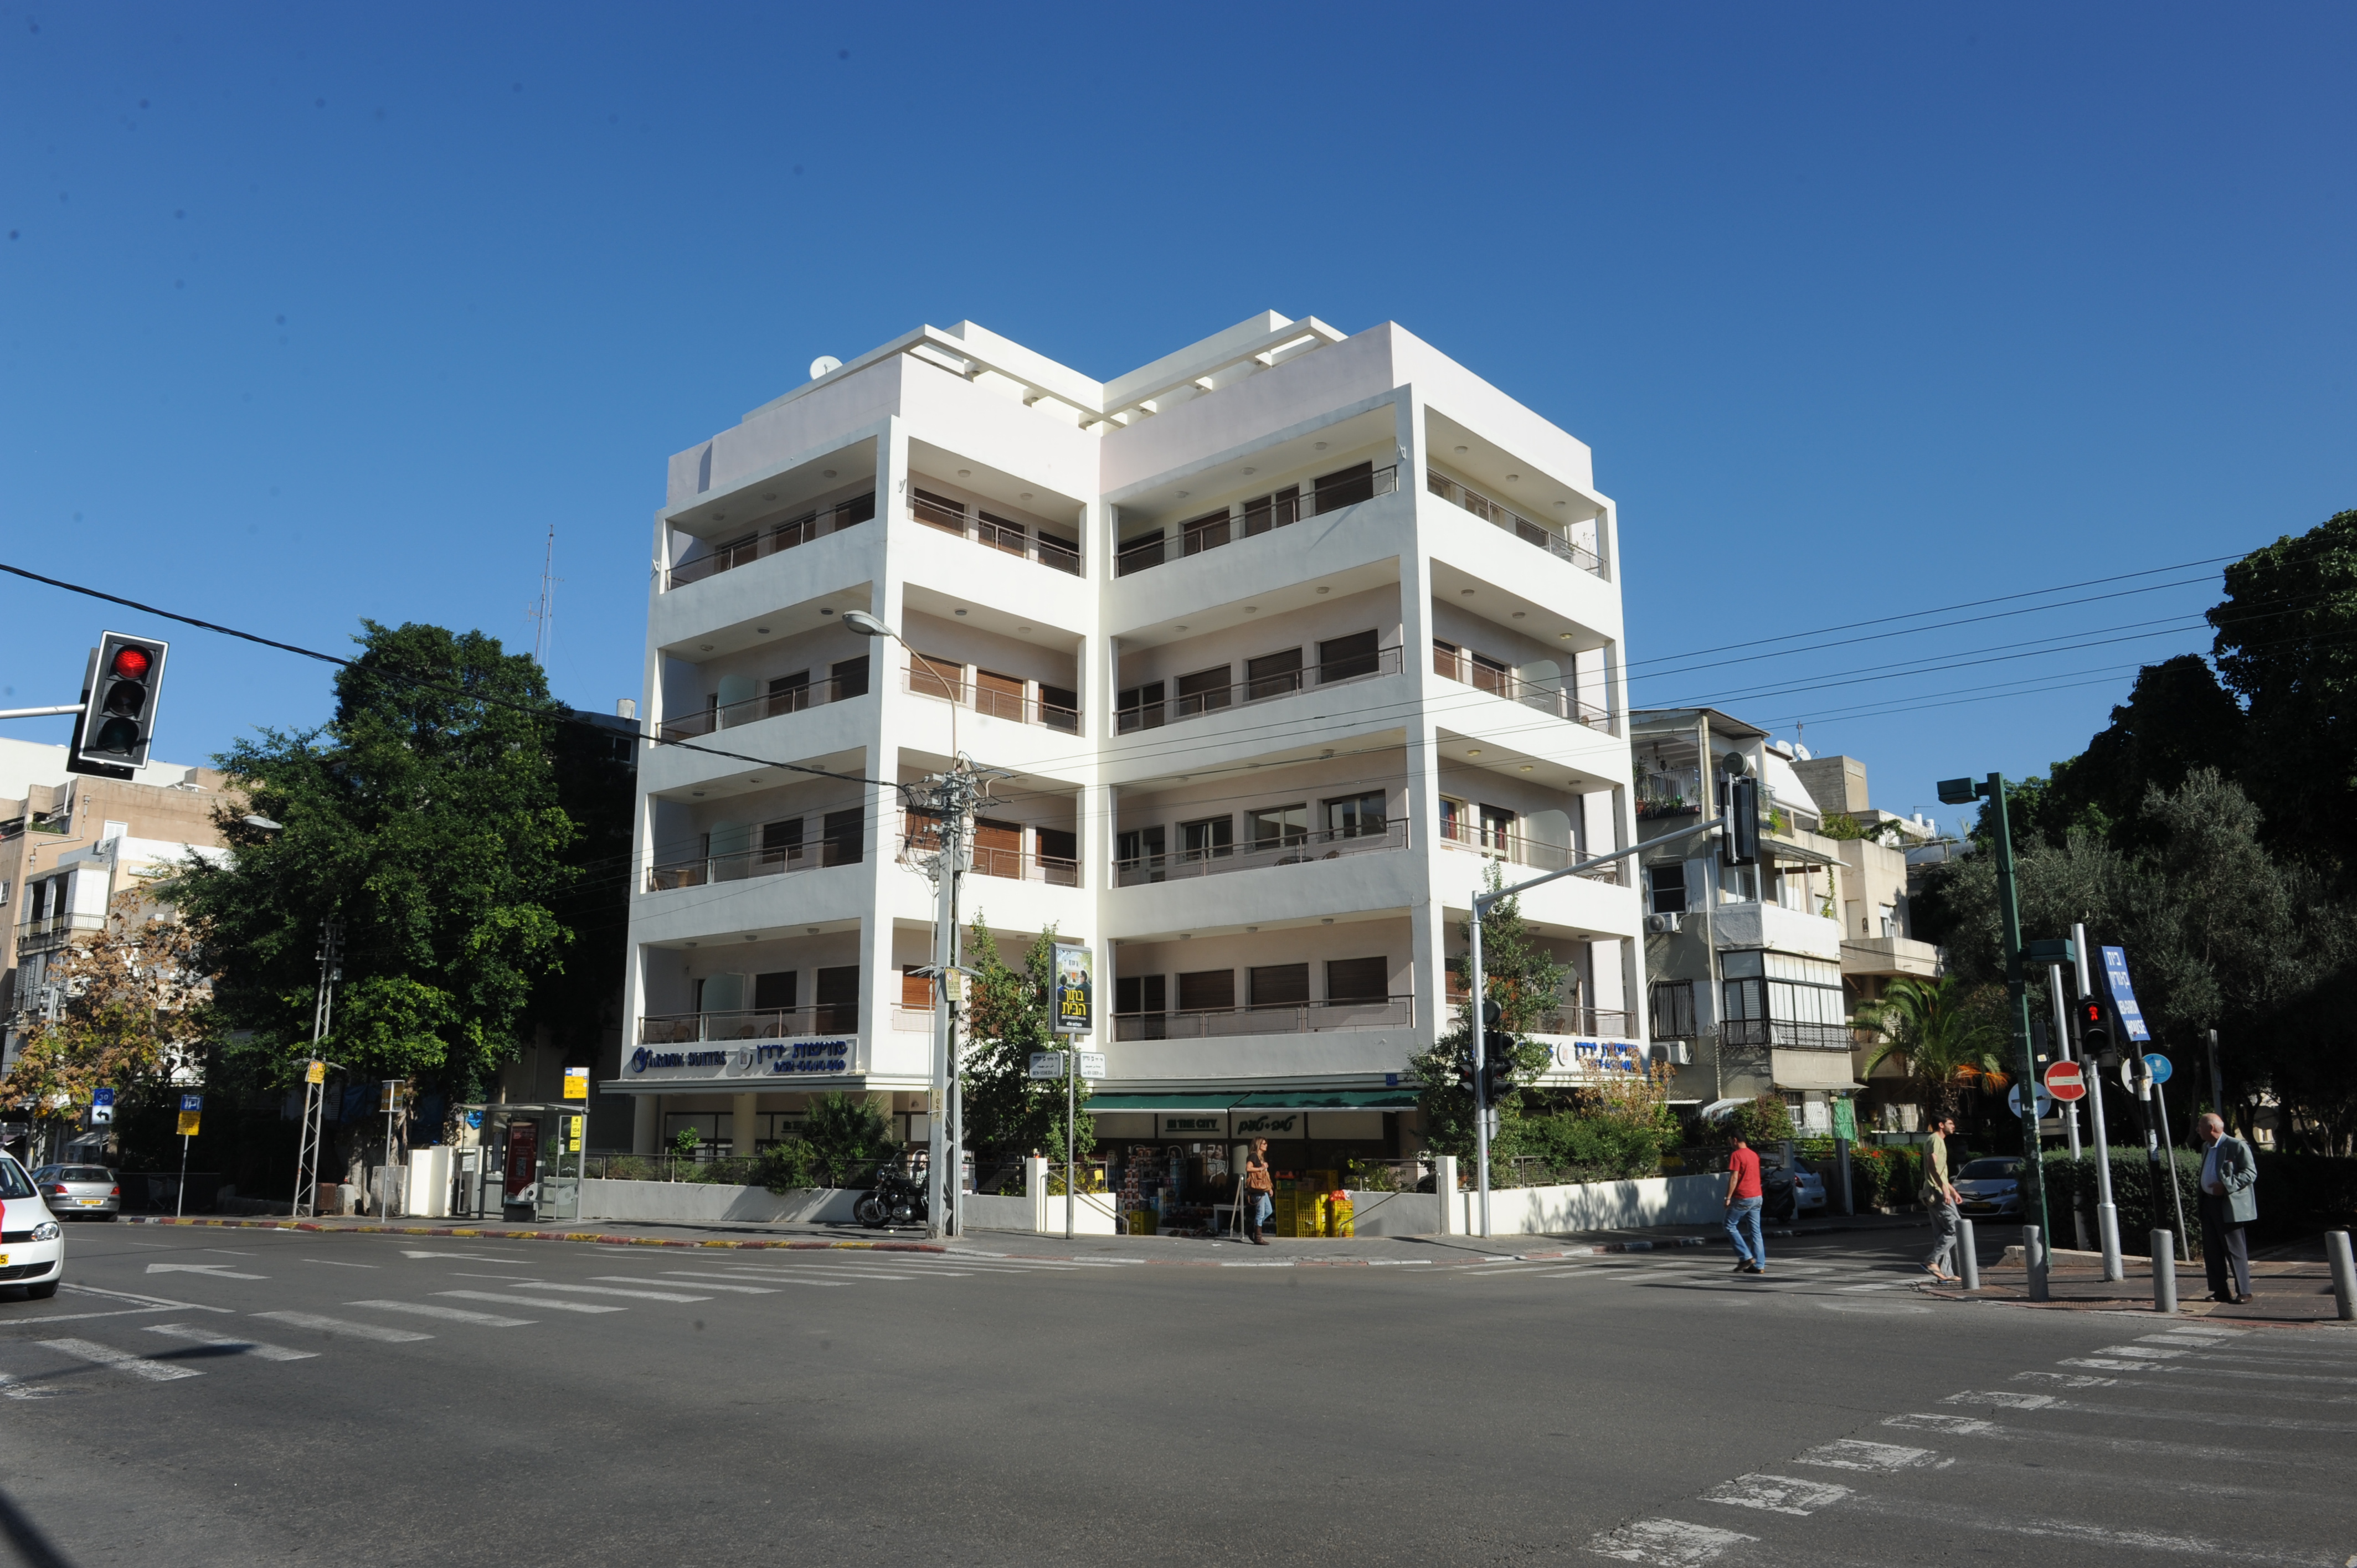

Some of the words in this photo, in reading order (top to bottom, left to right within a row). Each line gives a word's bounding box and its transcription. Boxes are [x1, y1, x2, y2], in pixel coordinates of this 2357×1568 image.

[2107, 952, 2122, 966] בית
[1063, 989, 1084, 1003] בתוך
[1061, 1002, 1086, 1016] הבית
[2126, 1020, 2147, 1034] HOUSE
[687, 1050, 727, 1066] SUITES
[756, 1044, 786, 1064] ירדן
[1177, 1119, 1195, 1128] THE
[1196, 1119, 1217, 1128] CITY
